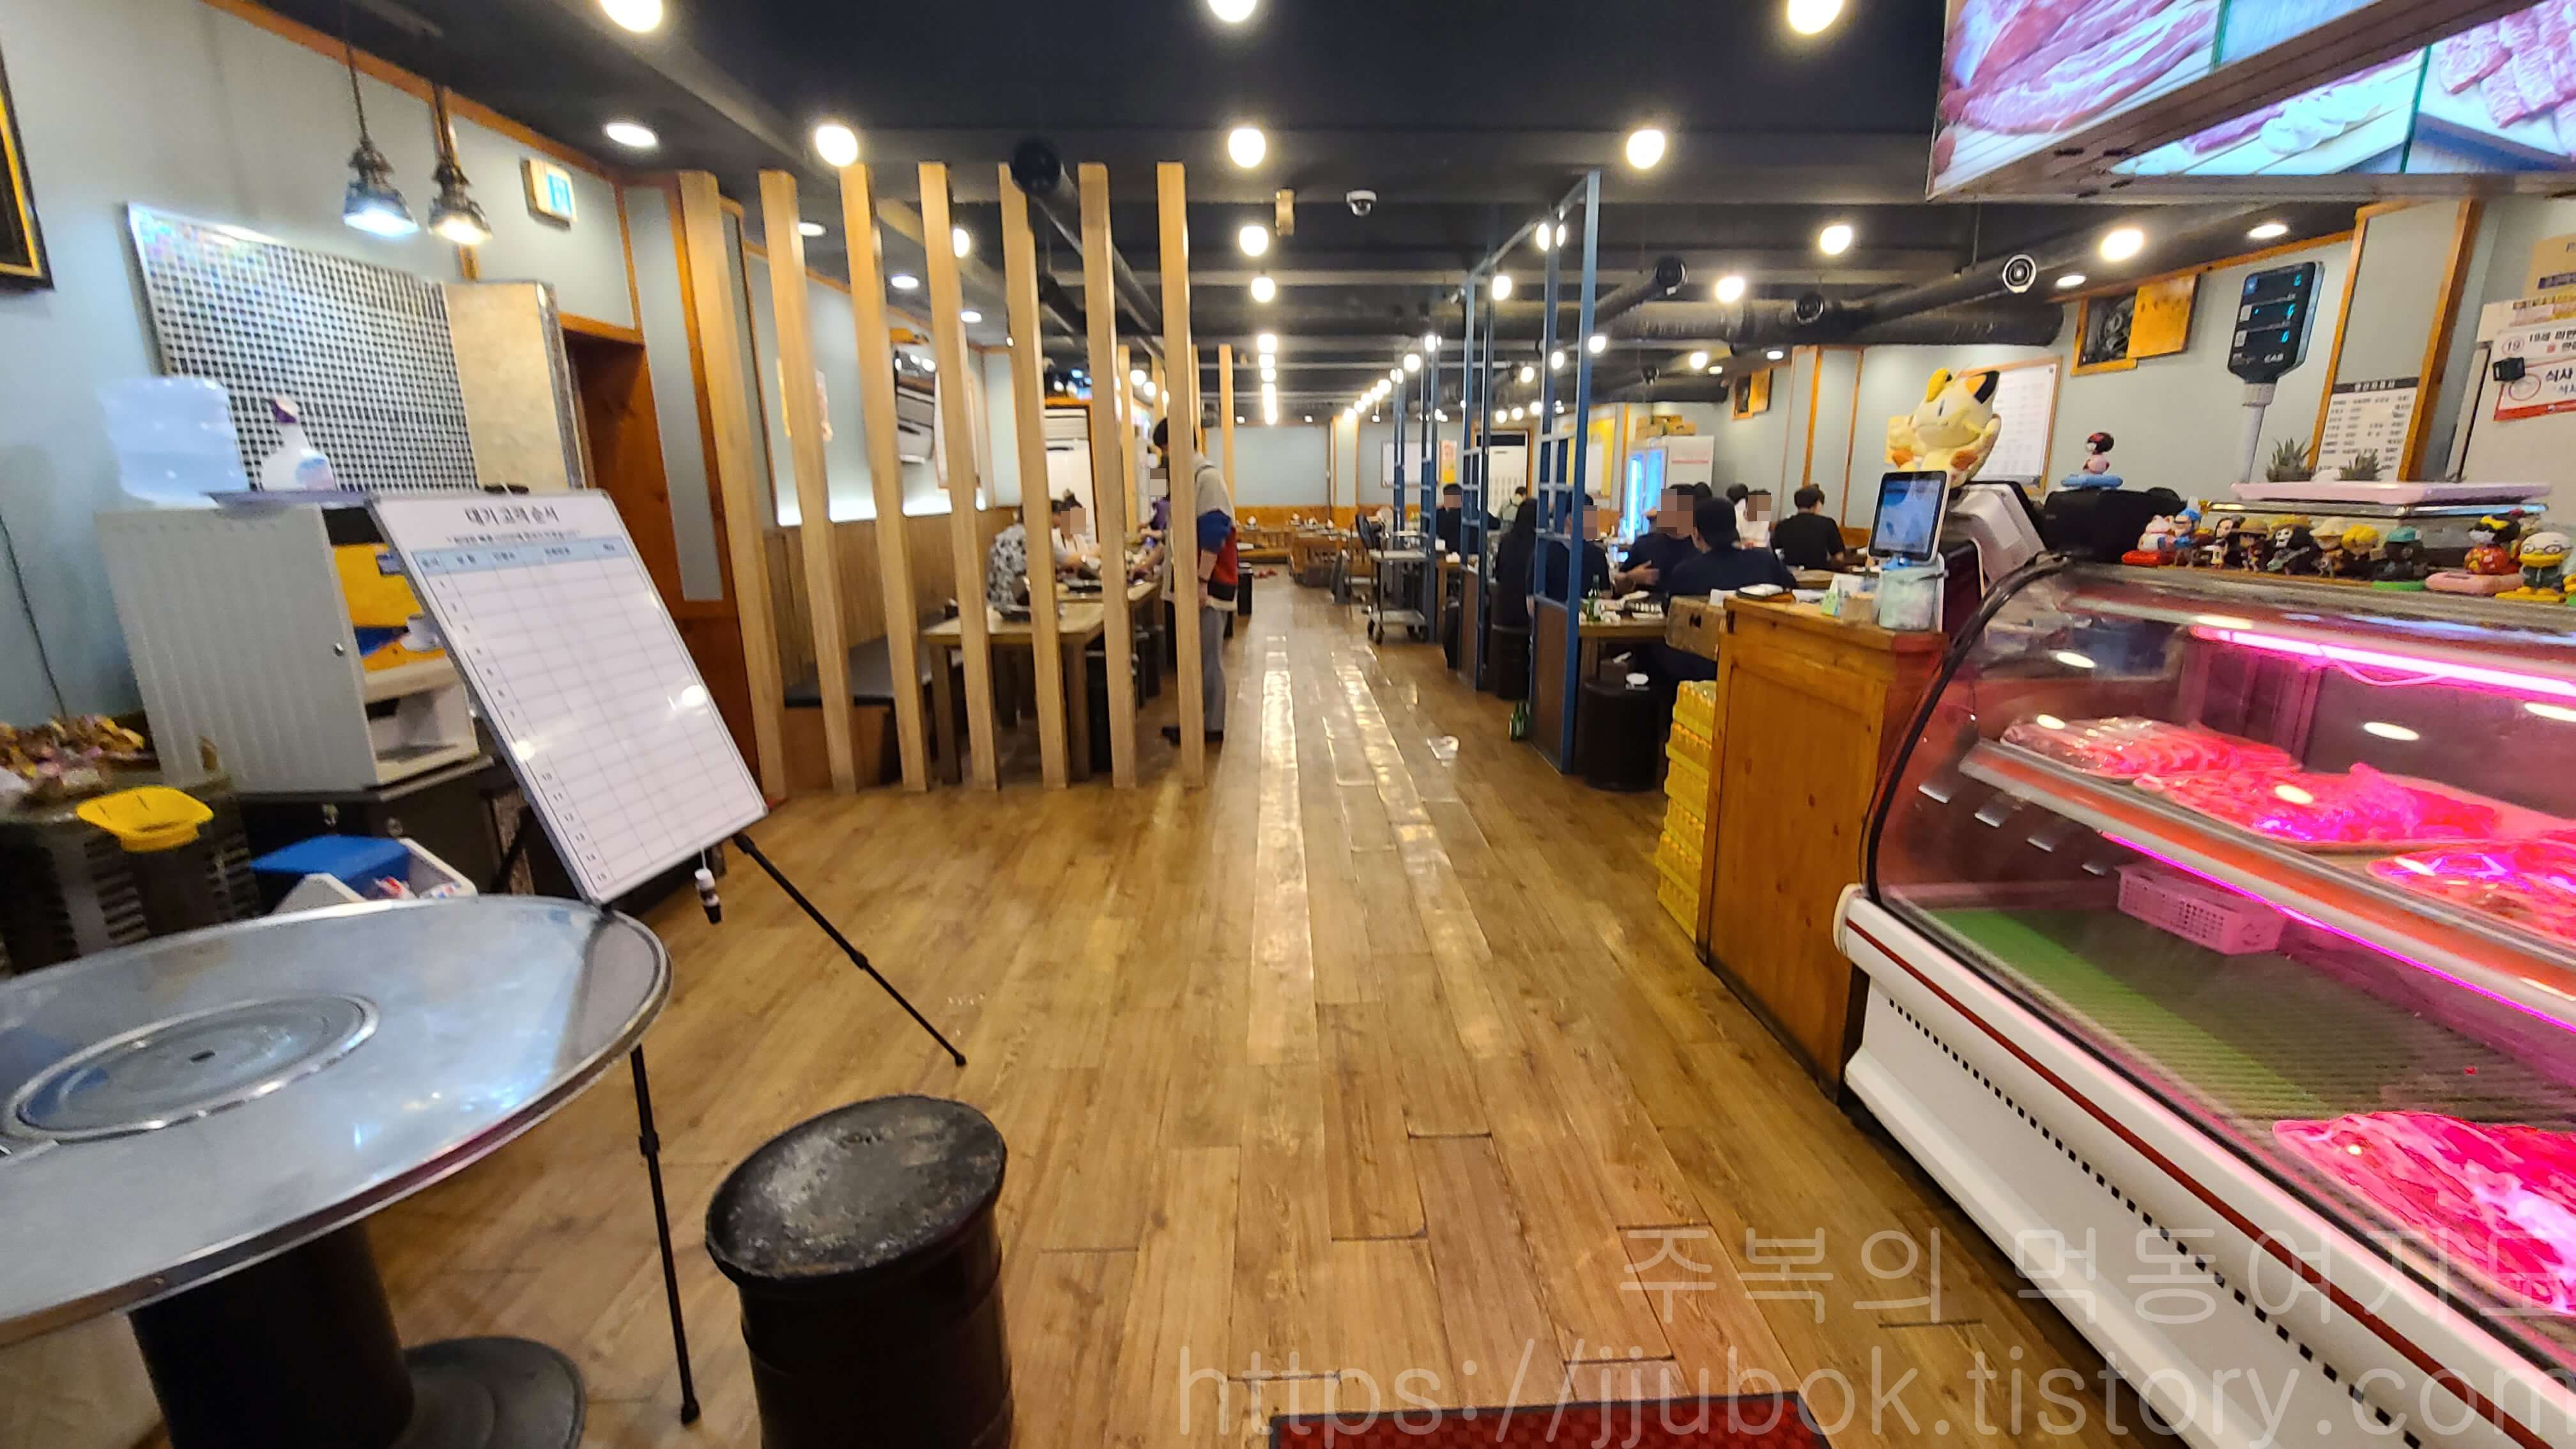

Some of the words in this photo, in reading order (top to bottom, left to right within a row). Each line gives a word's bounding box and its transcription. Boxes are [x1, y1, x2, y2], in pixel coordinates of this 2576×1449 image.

[2508, 341, 2521, 351] 19
[465, 506, 500, 526] 대기
[500, 506, 531, 525] 고객
[532, 505, 560, 525] 순서
